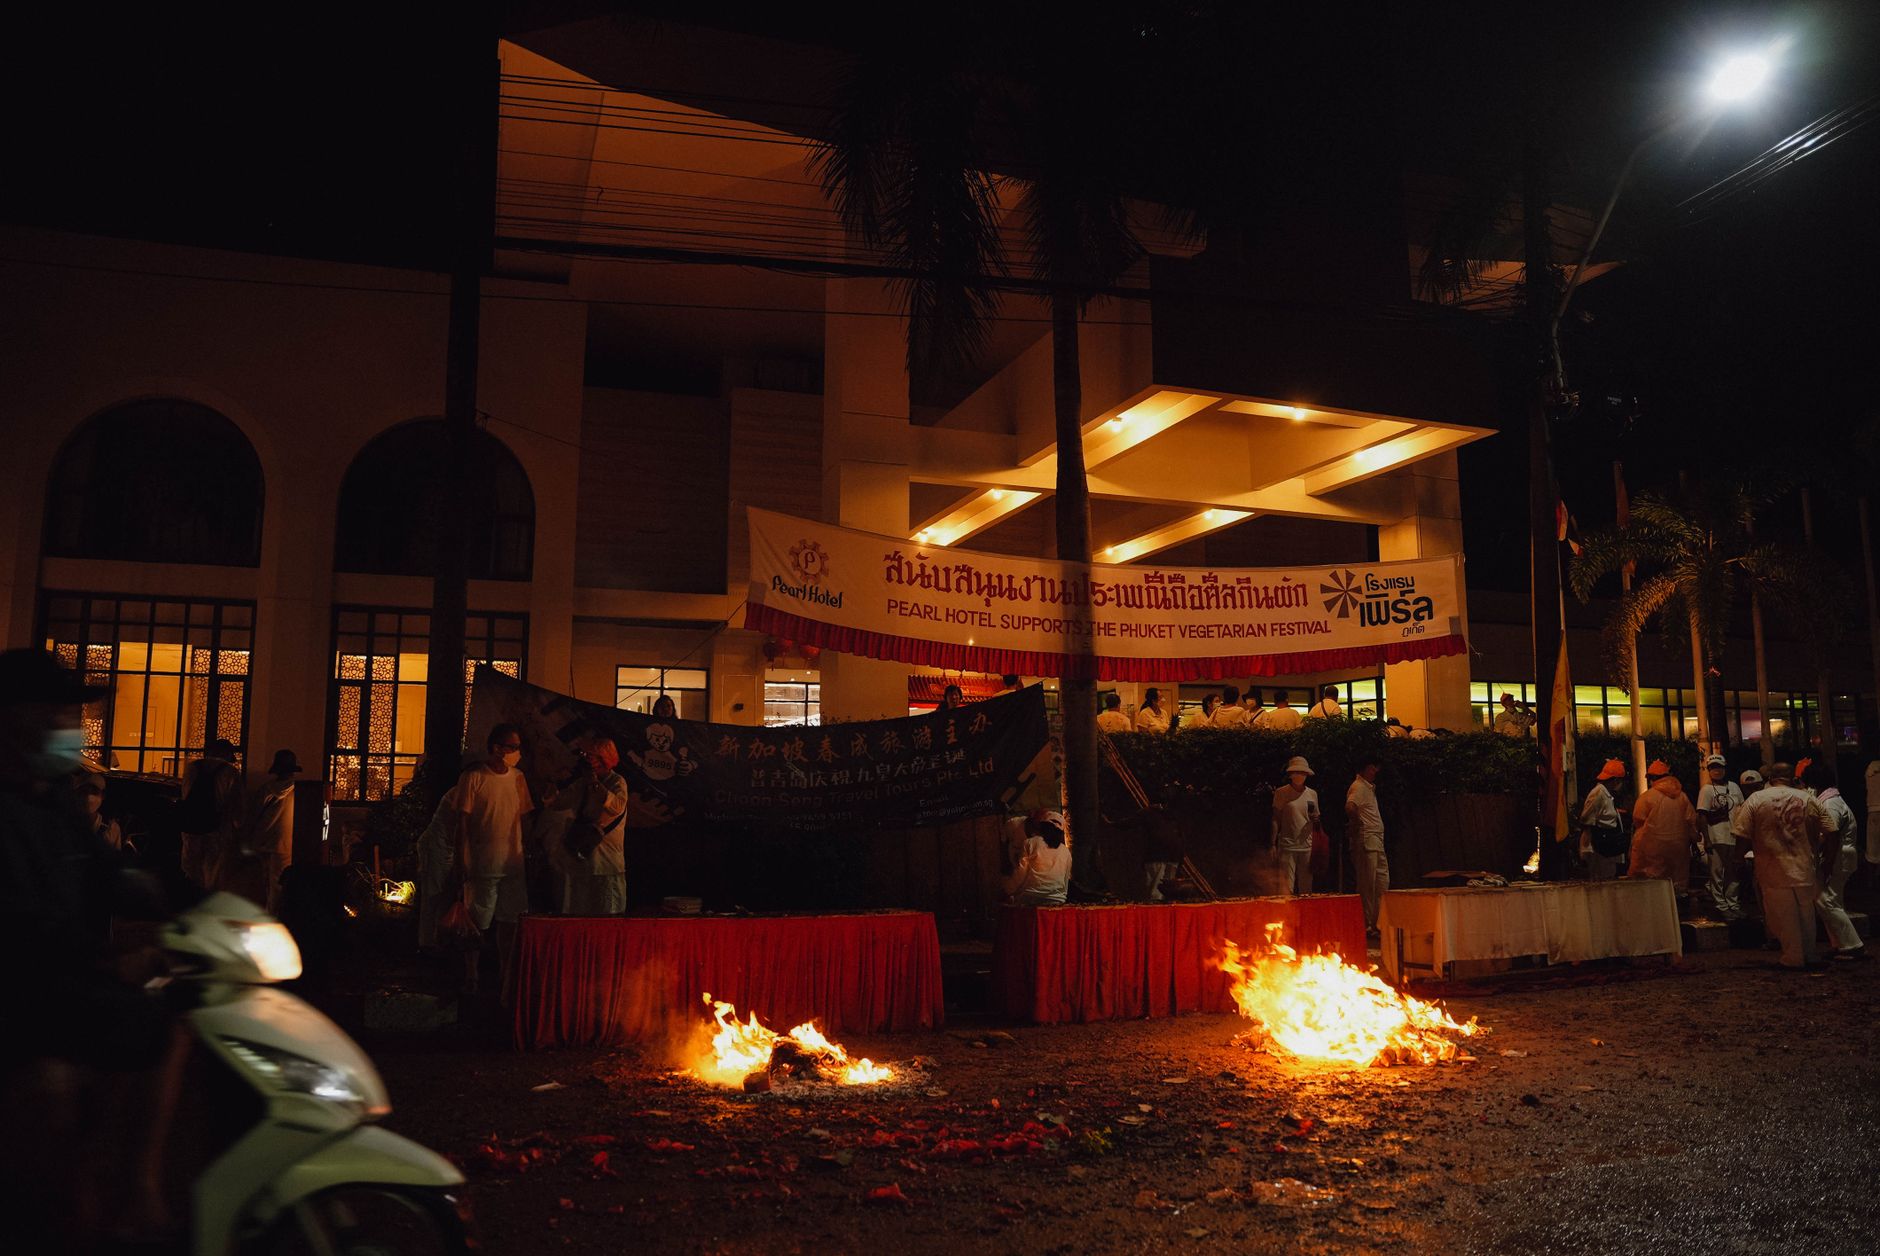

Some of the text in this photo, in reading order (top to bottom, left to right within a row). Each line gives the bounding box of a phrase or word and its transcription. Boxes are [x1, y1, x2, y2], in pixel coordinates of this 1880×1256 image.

[771, 575, 843, 609] Pearl Hotel
[1365, 573, 1415, 592] โรงแรม
[887, 599, 1331, 639] PEARL HOTEL SUPPORTS THE PHUKET VEGETARIAN FESTIVAL
[1359, 589, 1433, 627] เพิร์ล
[968, 757, 995, 778] Ltd
